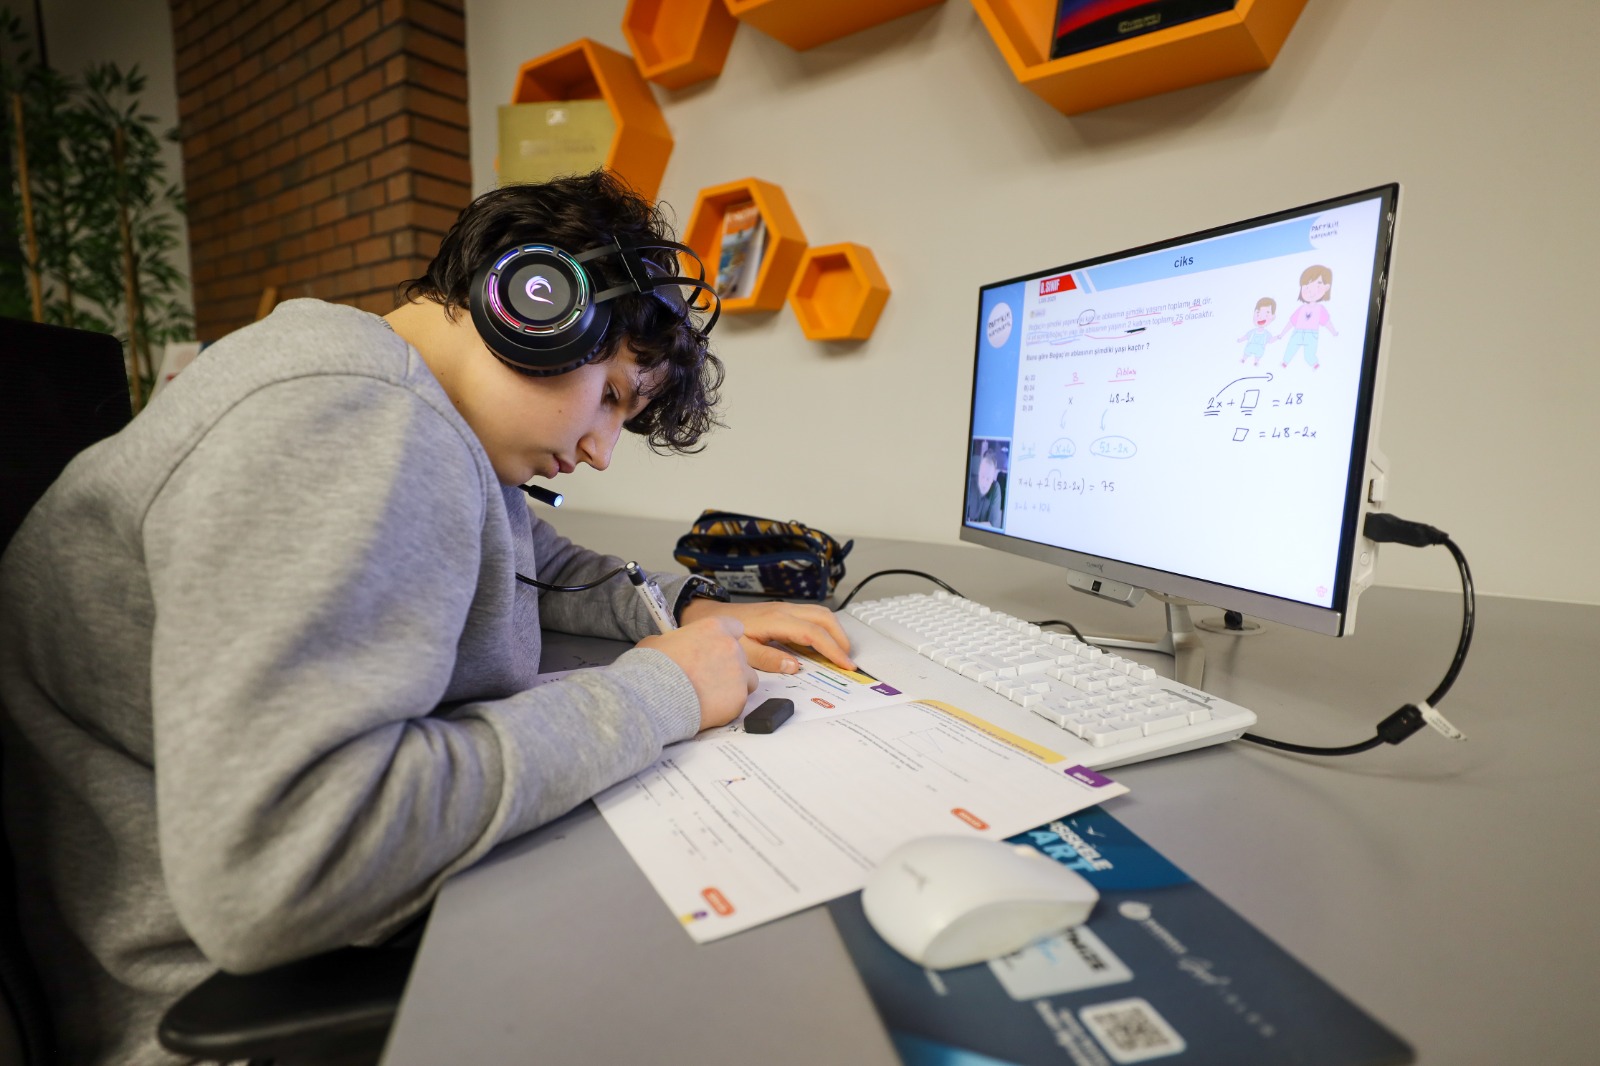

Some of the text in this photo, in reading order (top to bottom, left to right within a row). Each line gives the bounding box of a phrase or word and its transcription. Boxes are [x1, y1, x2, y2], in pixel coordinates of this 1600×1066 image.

[1174, 255, 1194, 268] ciks
[1192, 297, 1201, 306] 48
[1175, 313, 1184, 321] 75
[1206, 396, 1223, 409] 2x
[1285, 392, 1304, 405] 48
[1101, 480, 1115, 492] 75
